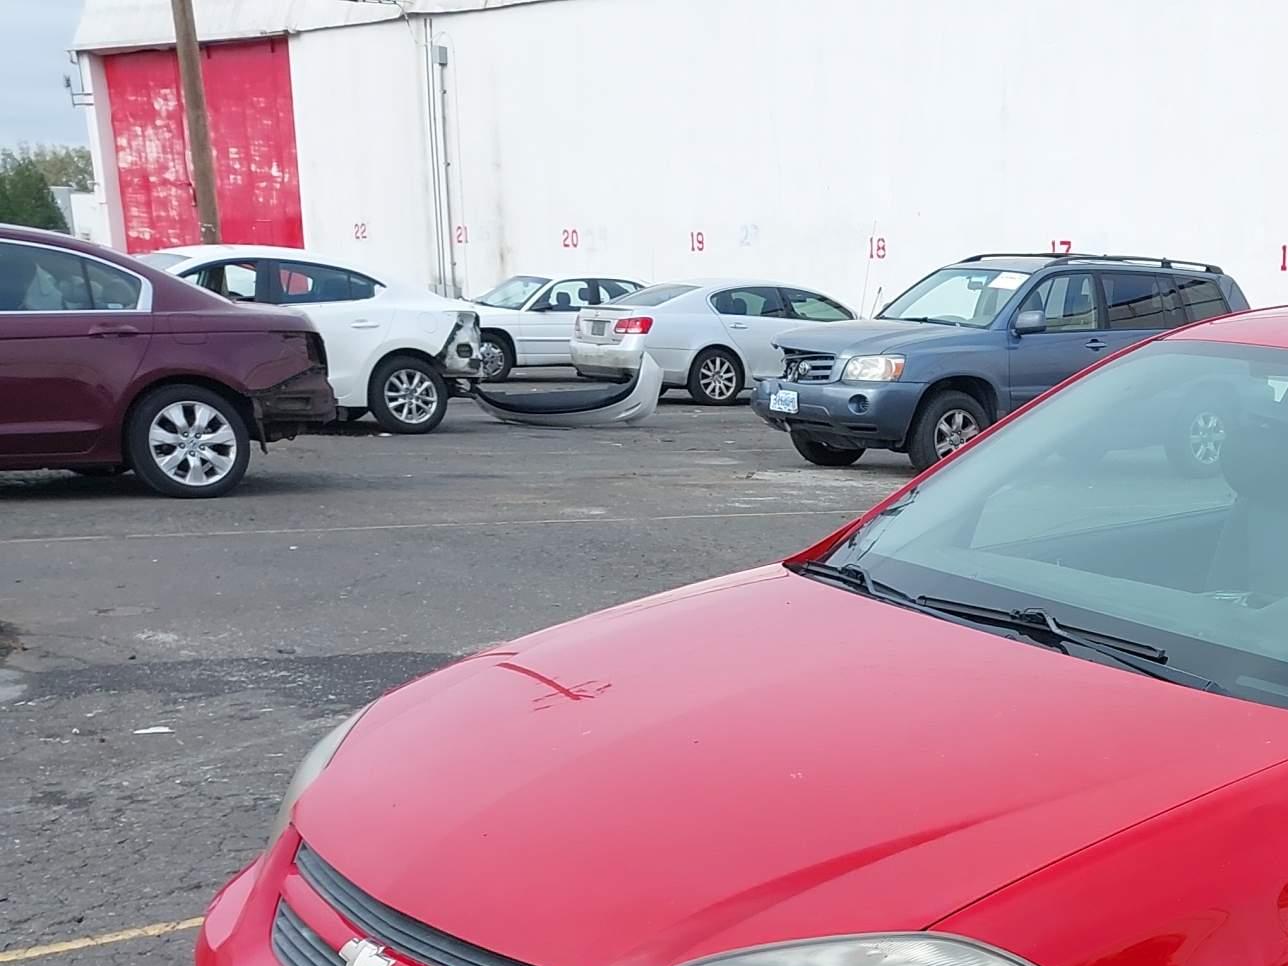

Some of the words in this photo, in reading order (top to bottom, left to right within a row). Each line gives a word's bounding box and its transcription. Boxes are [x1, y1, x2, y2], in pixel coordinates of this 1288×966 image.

[353, 223, 368, 240] 22
[455, 225, 470, 244] 21
[561, 228, 580, 249] 20
[690, 231, 706, 253] 19
[868, 236, 887, 259] 18
